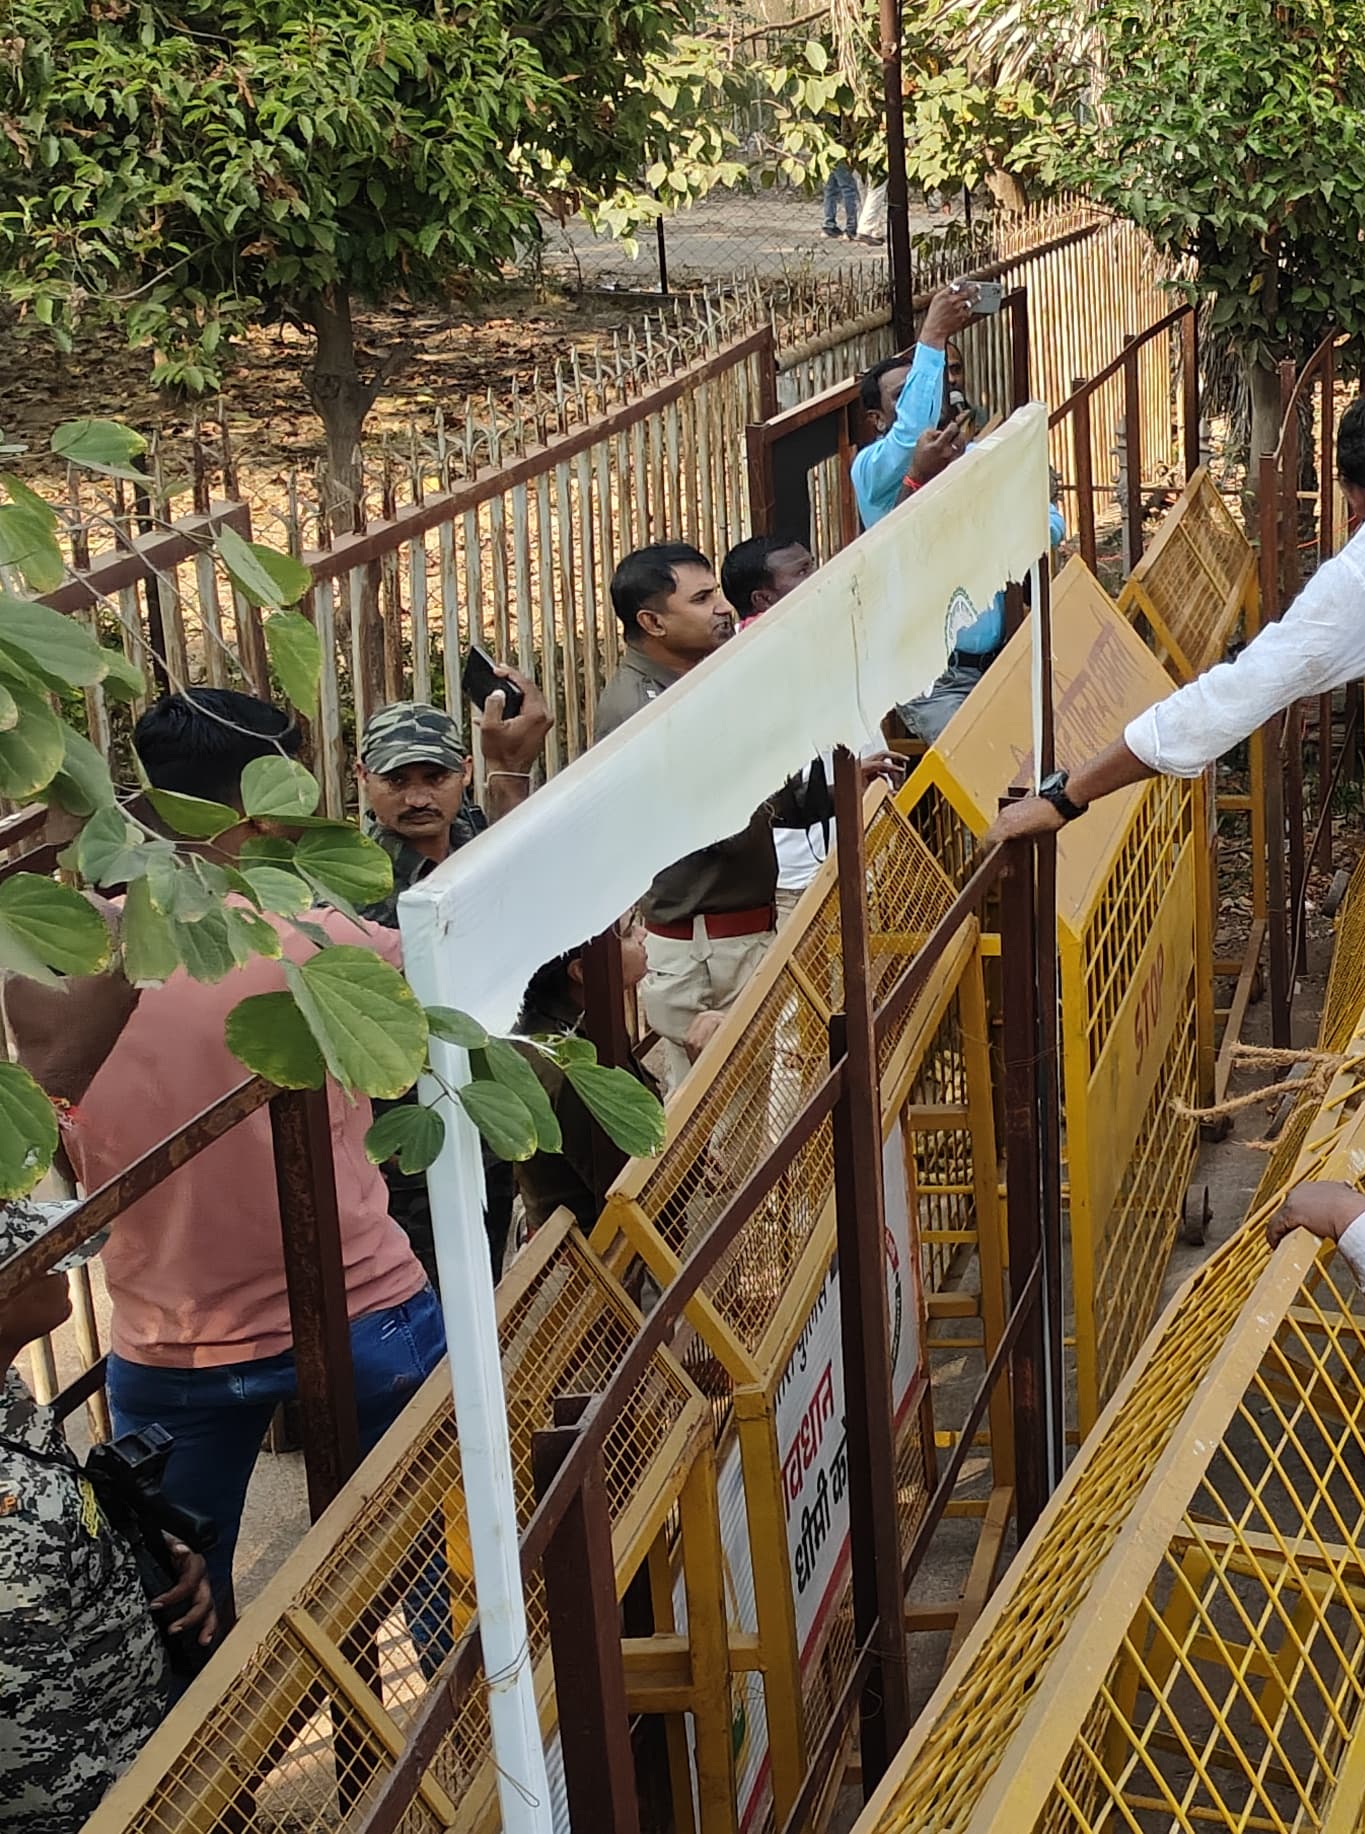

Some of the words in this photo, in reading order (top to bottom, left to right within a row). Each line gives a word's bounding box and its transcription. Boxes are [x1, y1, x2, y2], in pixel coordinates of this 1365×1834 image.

[1134, 942, 1165, 1076] STOP
[780, 1358, 834, 1523] ावधान
[795, 1467, 831, 1595] धीमी
[830, 1415, 849, 1505] क
